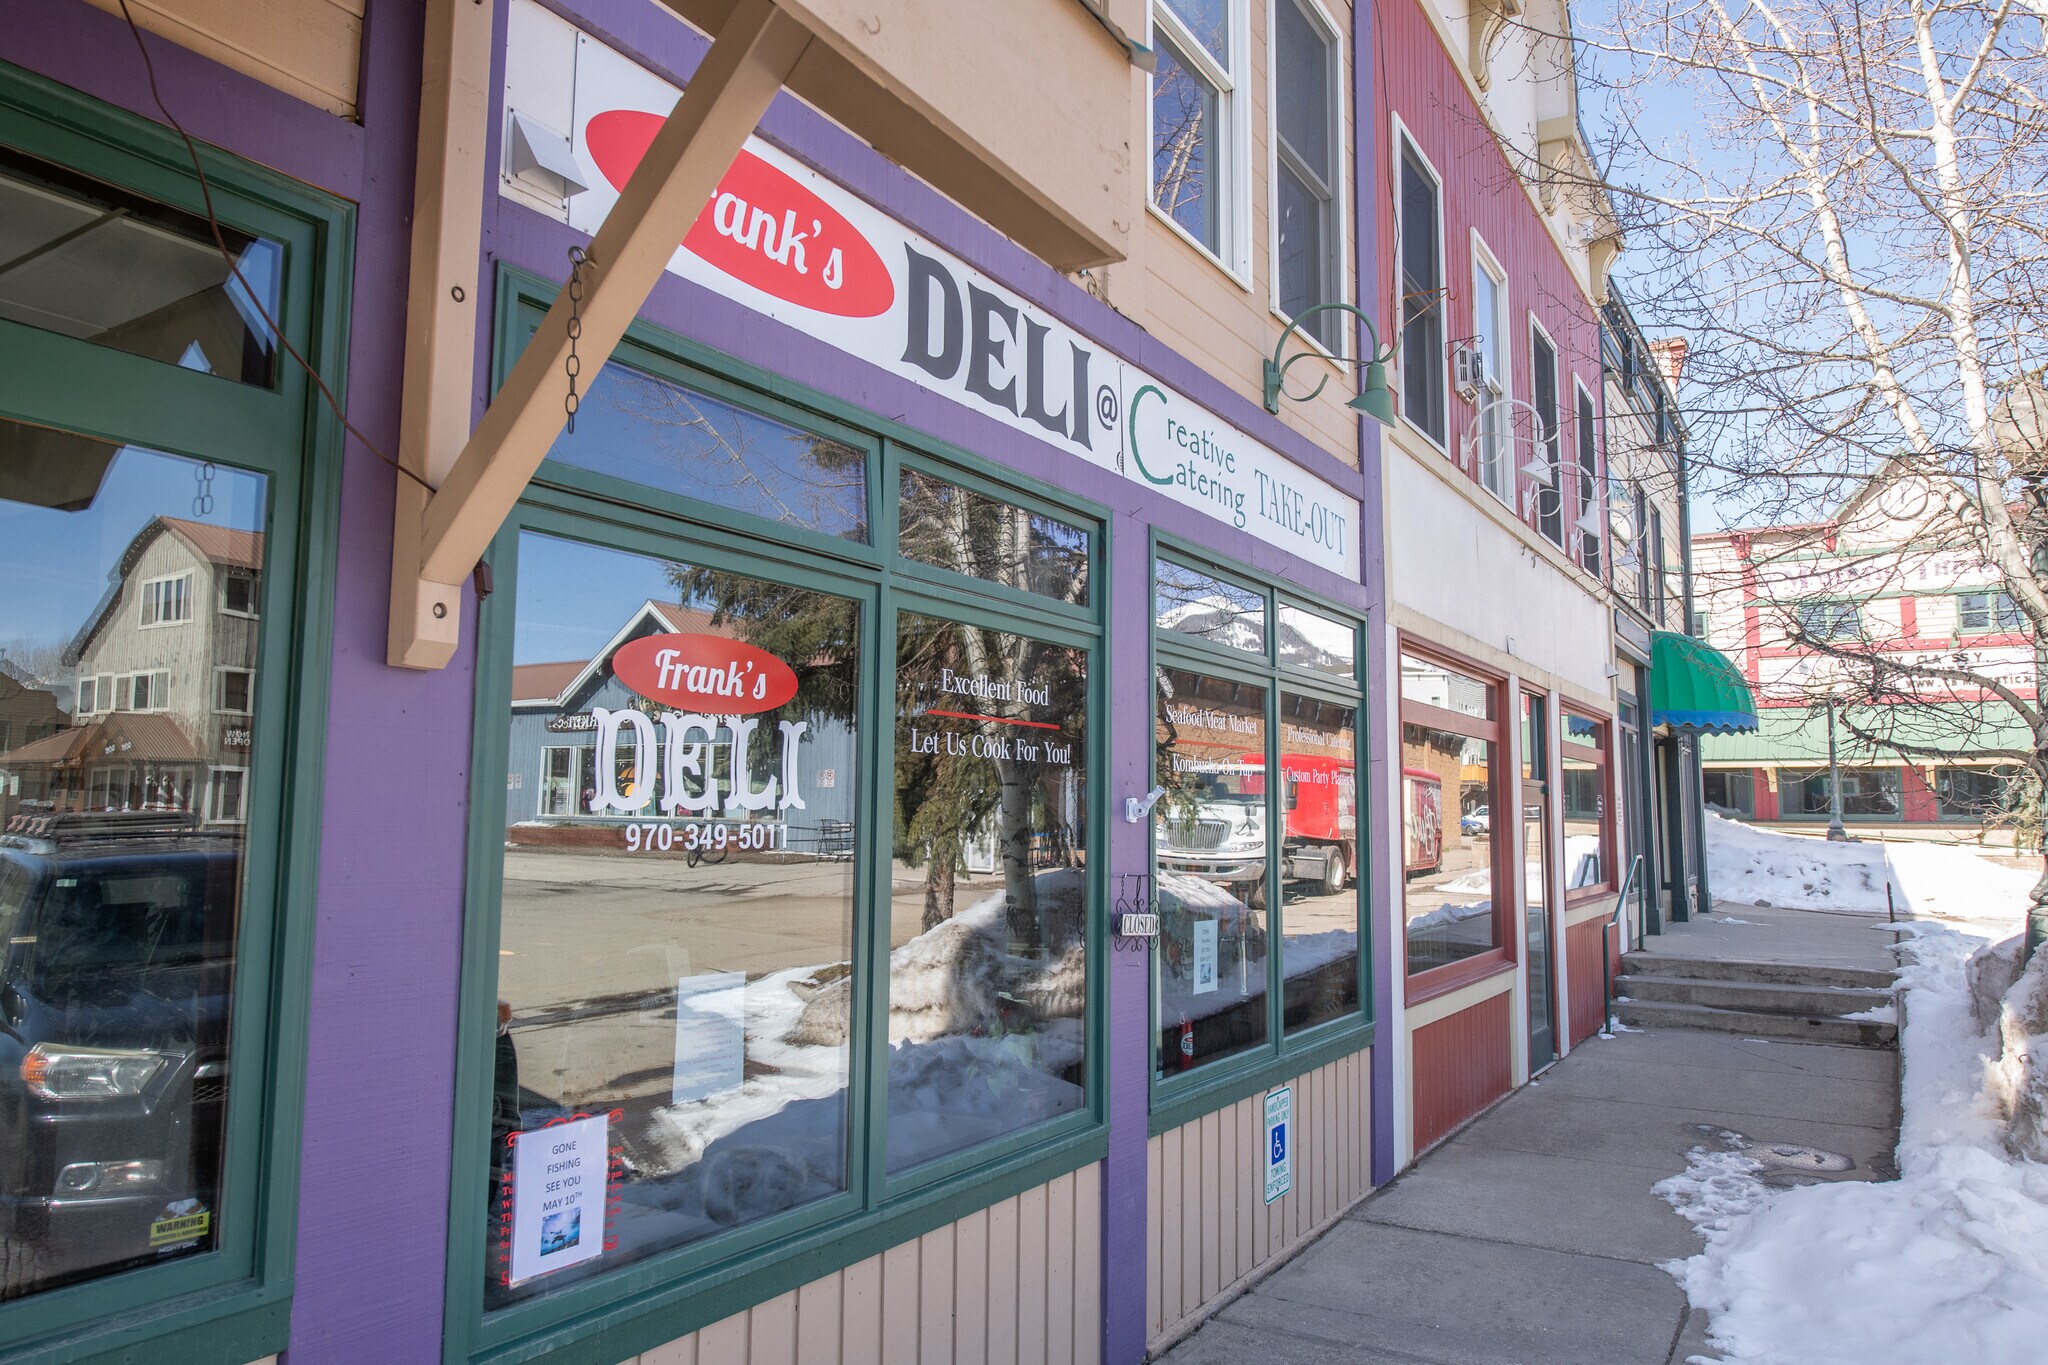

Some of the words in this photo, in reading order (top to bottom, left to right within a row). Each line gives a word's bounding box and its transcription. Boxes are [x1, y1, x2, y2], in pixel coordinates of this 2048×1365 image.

[710, 187, 843, 290] ank's
[900, 241, 1093, 453] DELI
[1096, 384, 1118, 431] @
[1254, 468, 1346, 556] TAKE-OUT
[654, 648, 767, 700] Frank's
[941, 668, 1011, 701] Excellent
[1017, 680, 1049, 706] Food
[1228, 714, 1257, 735] Market
[910, 728, 940, 754] Let
[946, 731, 967, 757] Us
[971, 734, 1011, 760] Cook
[1016, 738, 1039, 762] For
[1043, 741, 1072, 765] You!
[1287, 726, 1325, 746] Professional
[1325, 732, 1351, 754] Catering
[589, 707, 807, 812] DELI
[1172, 753, 1220, 776] Kombucha
[1222, 757, 1235, 776] On
[1236, 759, 1253, 782] Tap
[1286, 765, 1311, 783] Custom
[1312, 768, 1330, 789] Party
[624, 823, 788, 851] 970-349-5011
[1123, 915, 1154, 934] CLOSED
[552, 1141, 576, 1155] GONE
[547, 1158, 580, 1174] FISHING
[545, 1181, 561, 1194] SEE
[563, 1174, 581, 1191] YOU
[542, 1197, 563, 1213] MAY
[564, 1190, 583, 1206] 10TH
[156, 1215, 204, 1234] WARNING
